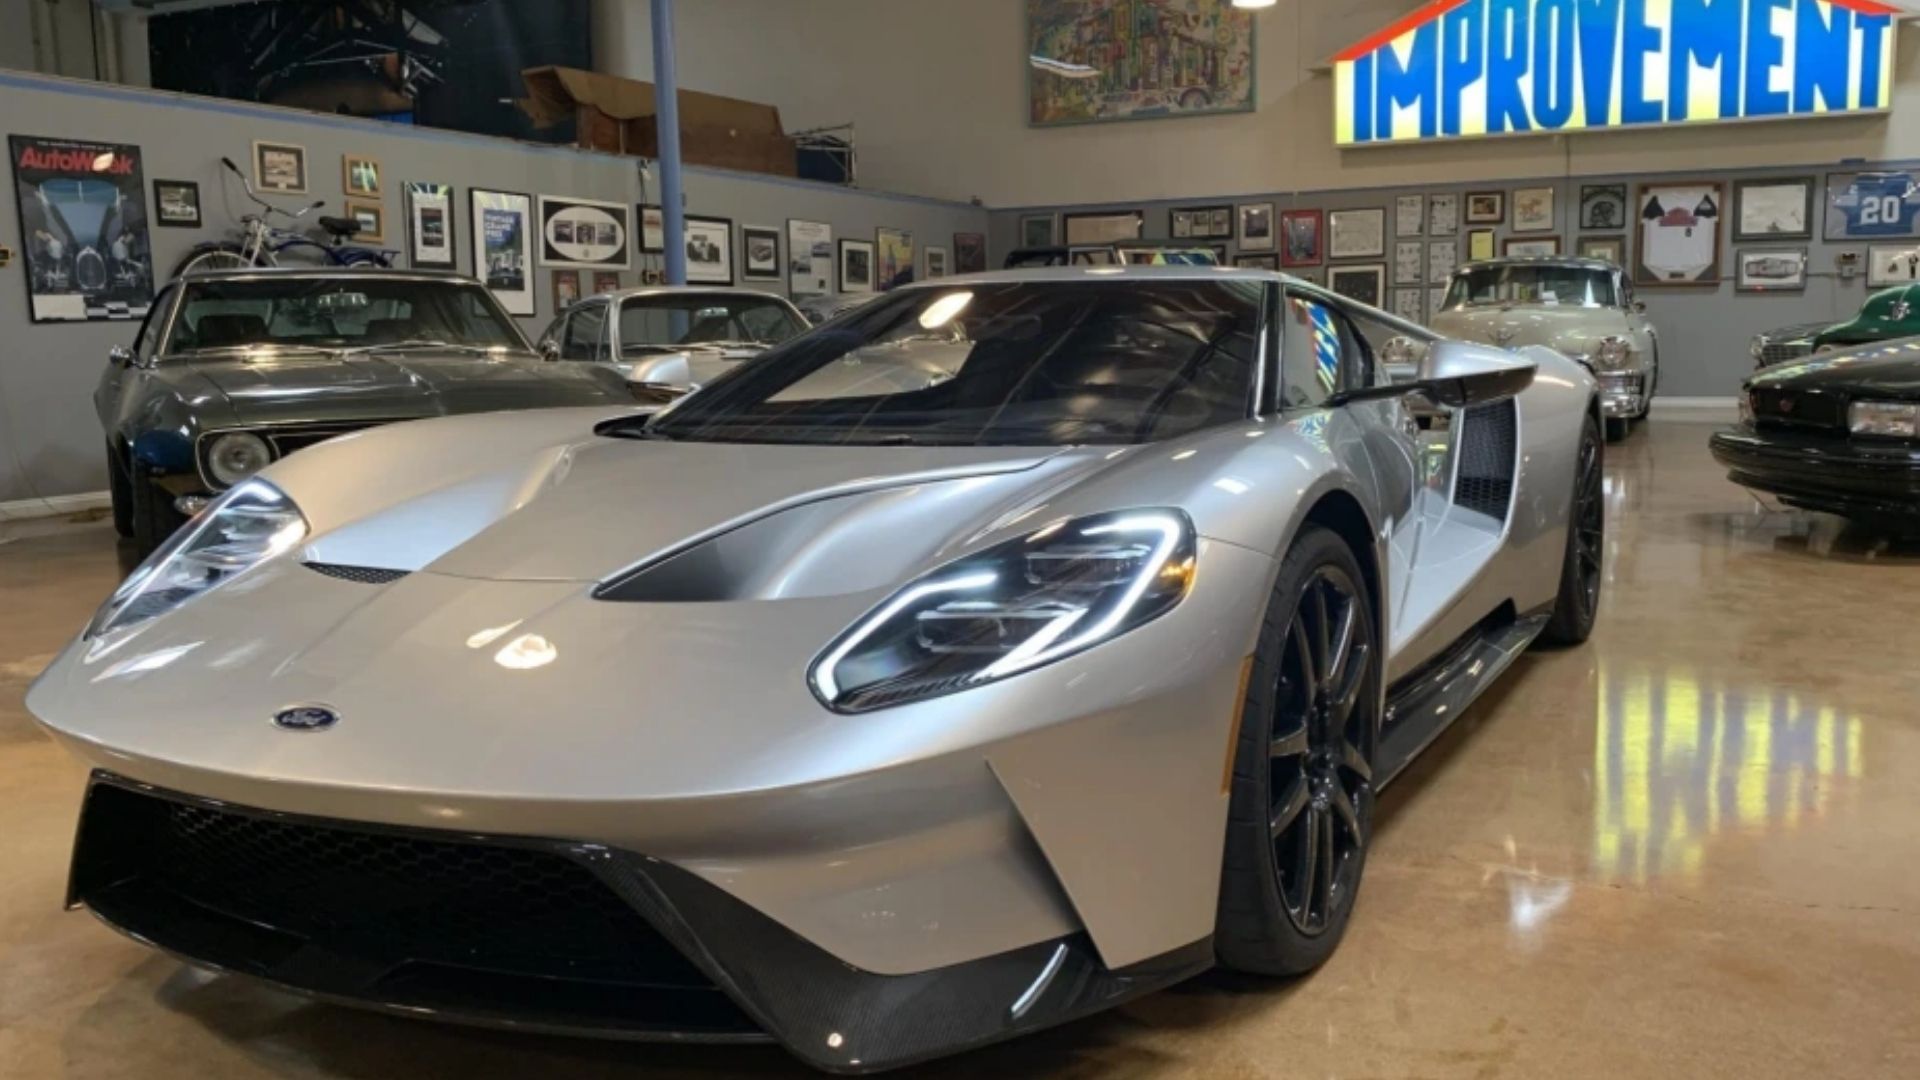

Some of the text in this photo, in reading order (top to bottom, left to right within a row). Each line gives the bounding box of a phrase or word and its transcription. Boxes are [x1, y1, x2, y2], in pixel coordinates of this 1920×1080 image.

[1353, 0, 1892, 142] IMPROVEMENT
[20, 145, 134, 174] AutoWek
[1861, 195, 1900, 225] 20
